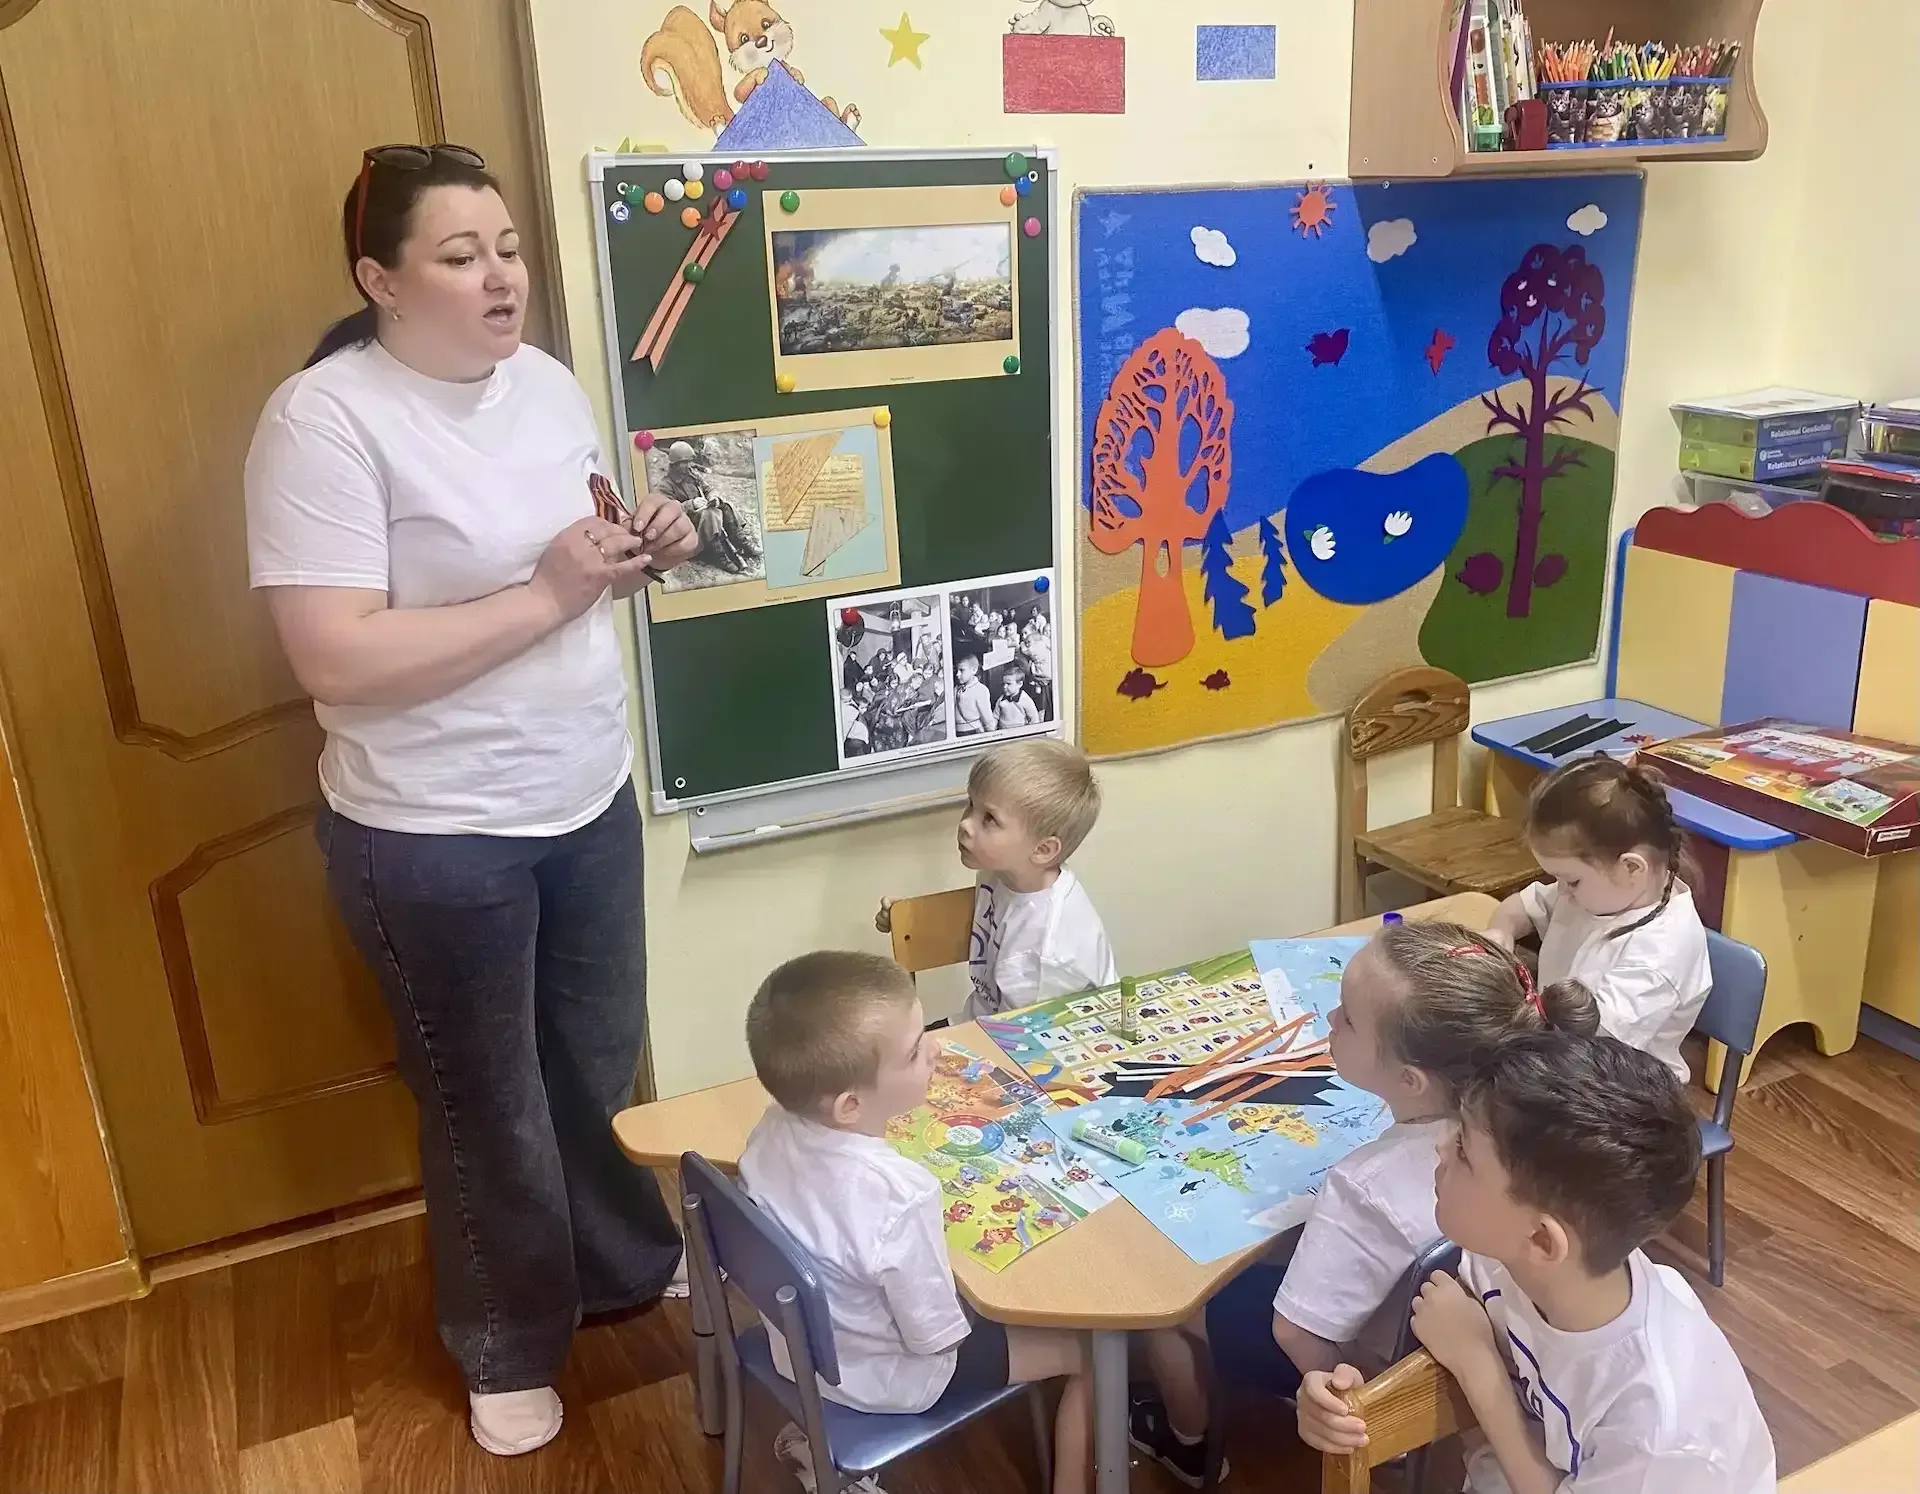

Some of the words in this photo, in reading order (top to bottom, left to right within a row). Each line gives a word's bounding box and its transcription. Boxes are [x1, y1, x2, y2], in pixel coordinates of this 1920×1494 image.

[1770, 426, 1801, 438] Relational
[1767, 459, 1798, 471] Relational
[1113, 1043, 1125, 1051] Т
